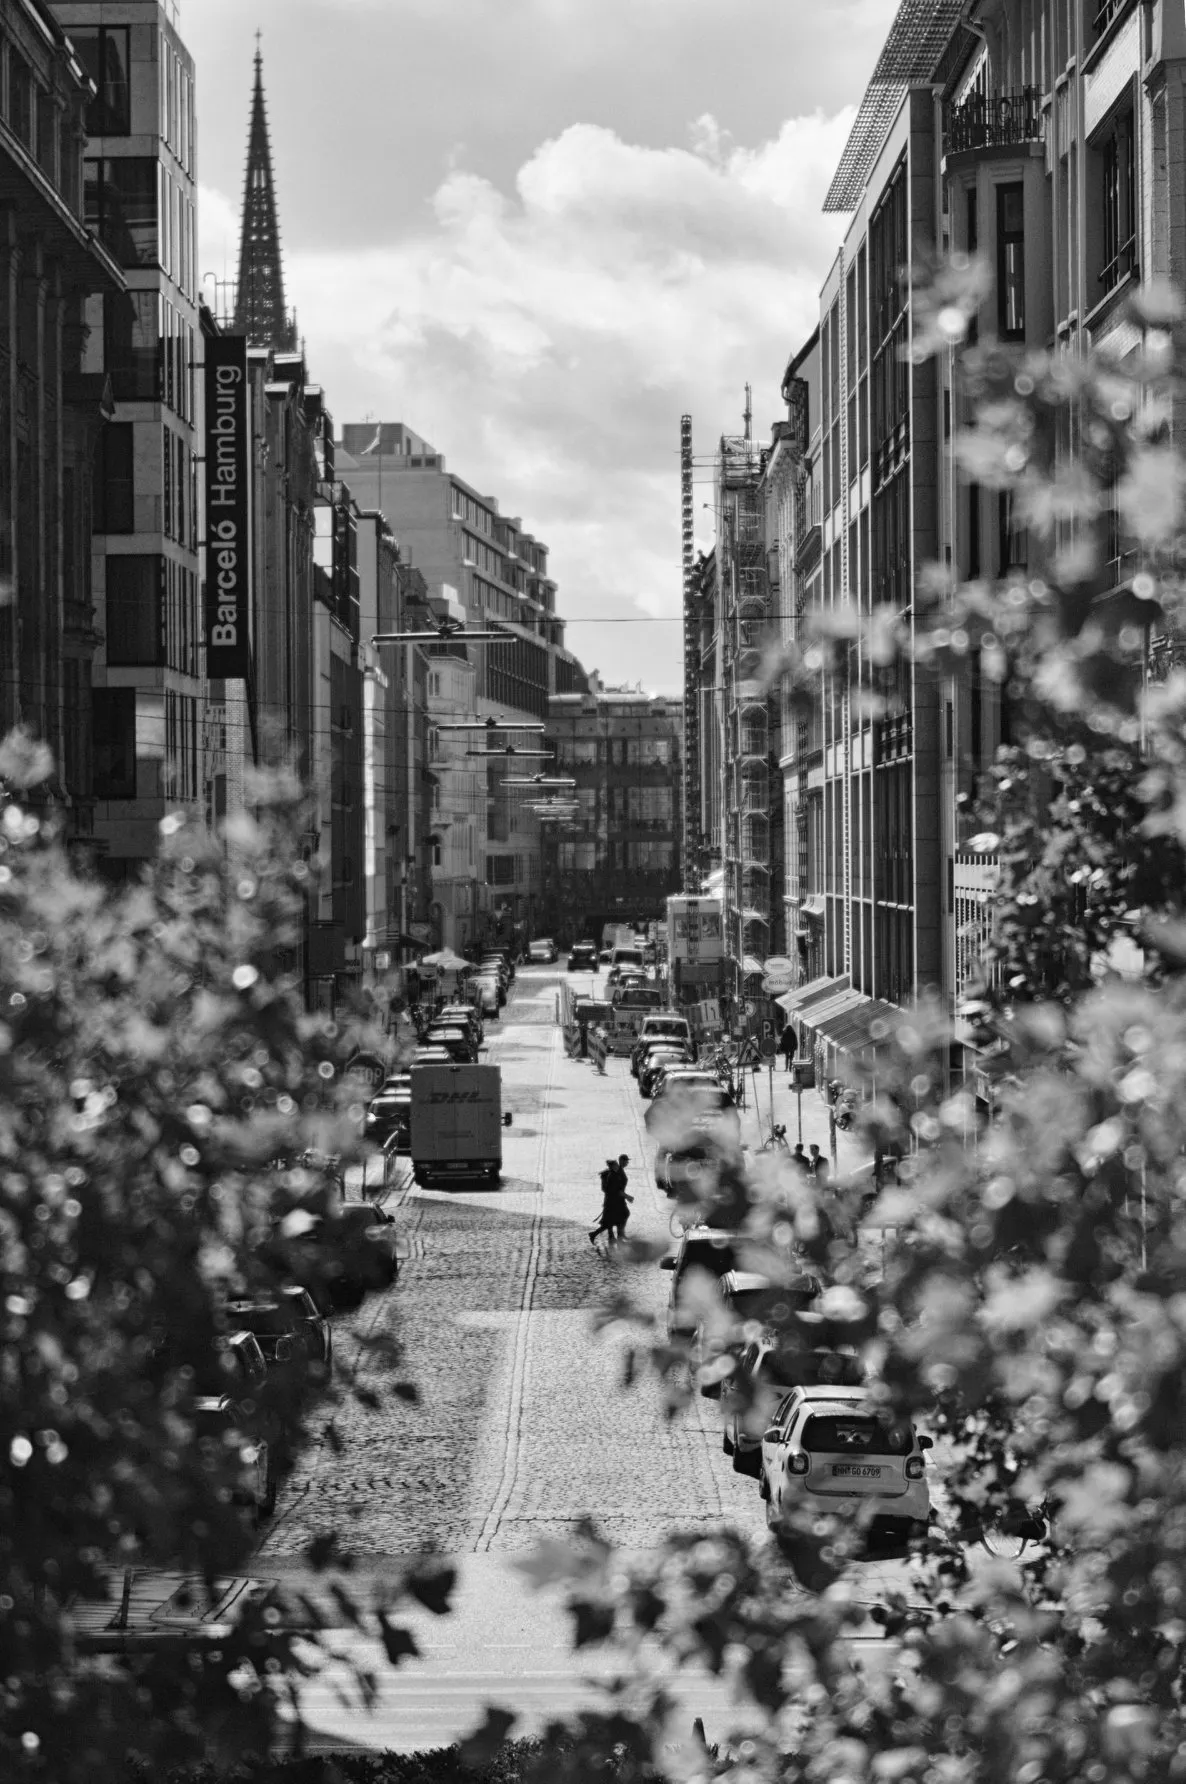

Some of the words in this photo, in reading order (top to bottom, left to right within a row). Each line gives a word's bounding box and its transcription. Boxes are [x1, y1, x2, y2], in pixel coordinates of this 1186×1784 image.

[211, 365, 241, 505] Hamburg
[210, 519, 237, 646] Barceló
[763, 1021, 771, 1039] P
[431, 1092, 479, 1104] DHL
[862, 1468, 880, 1477] 6709
